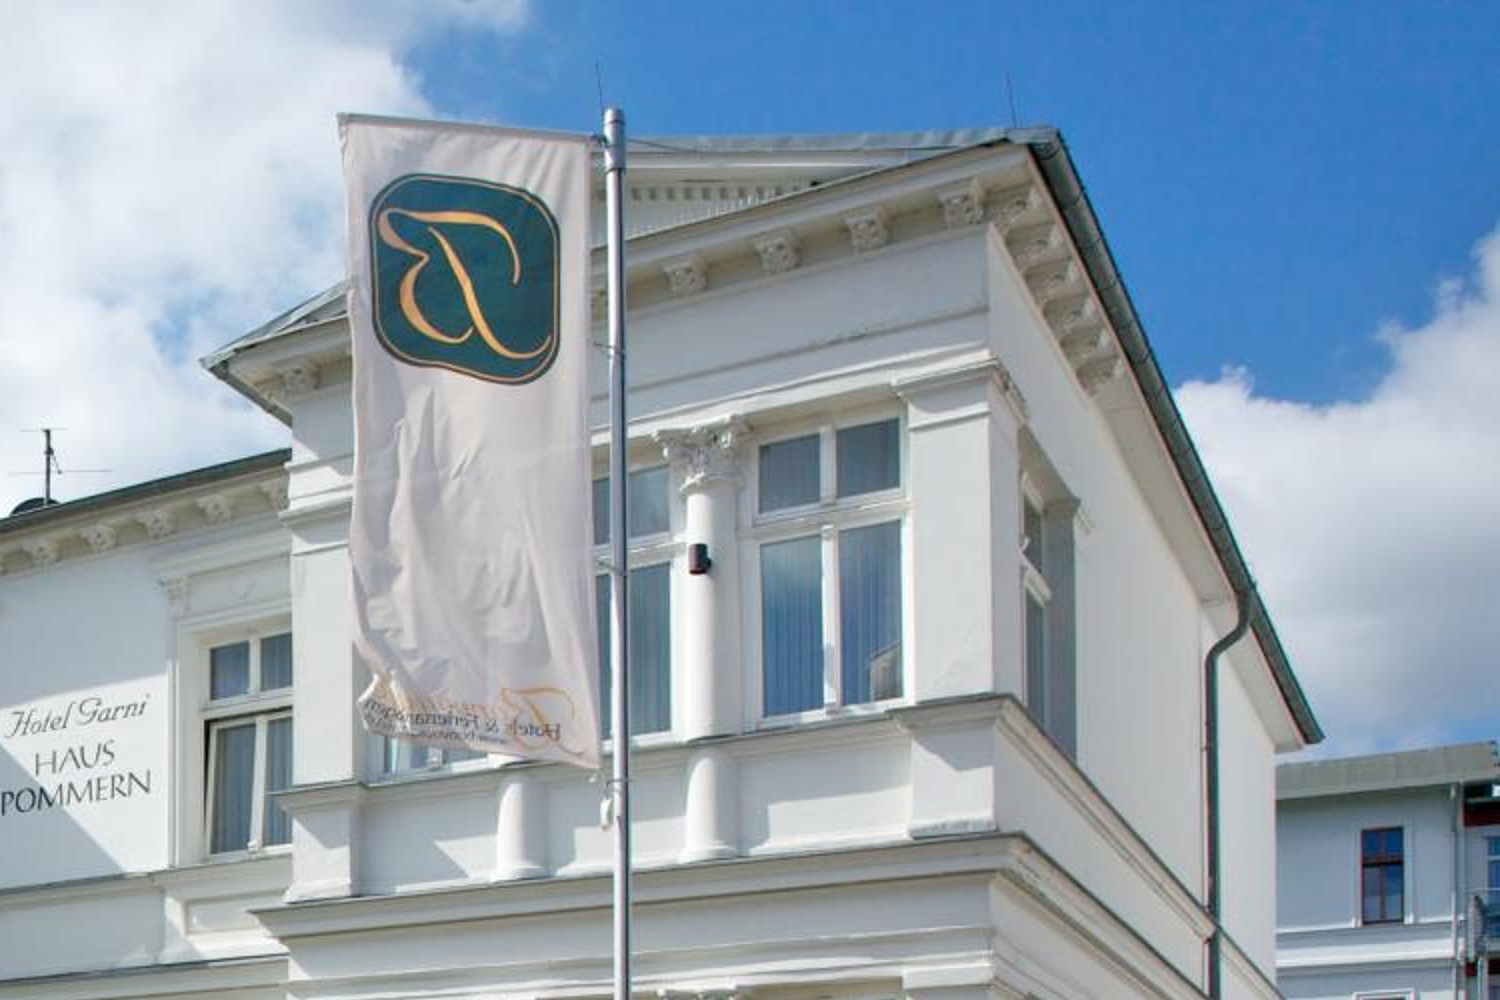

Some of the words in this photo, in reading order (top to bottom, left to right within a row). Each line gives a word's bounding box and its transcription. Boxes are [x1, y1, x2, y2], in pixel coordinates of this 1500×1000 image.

[4, 700, 76, 739] Hotel
[76, 692, 150, 725] Garni
[35, 739, 115, 776] HAUS
[1, 769, 151, 816] POMMERN
